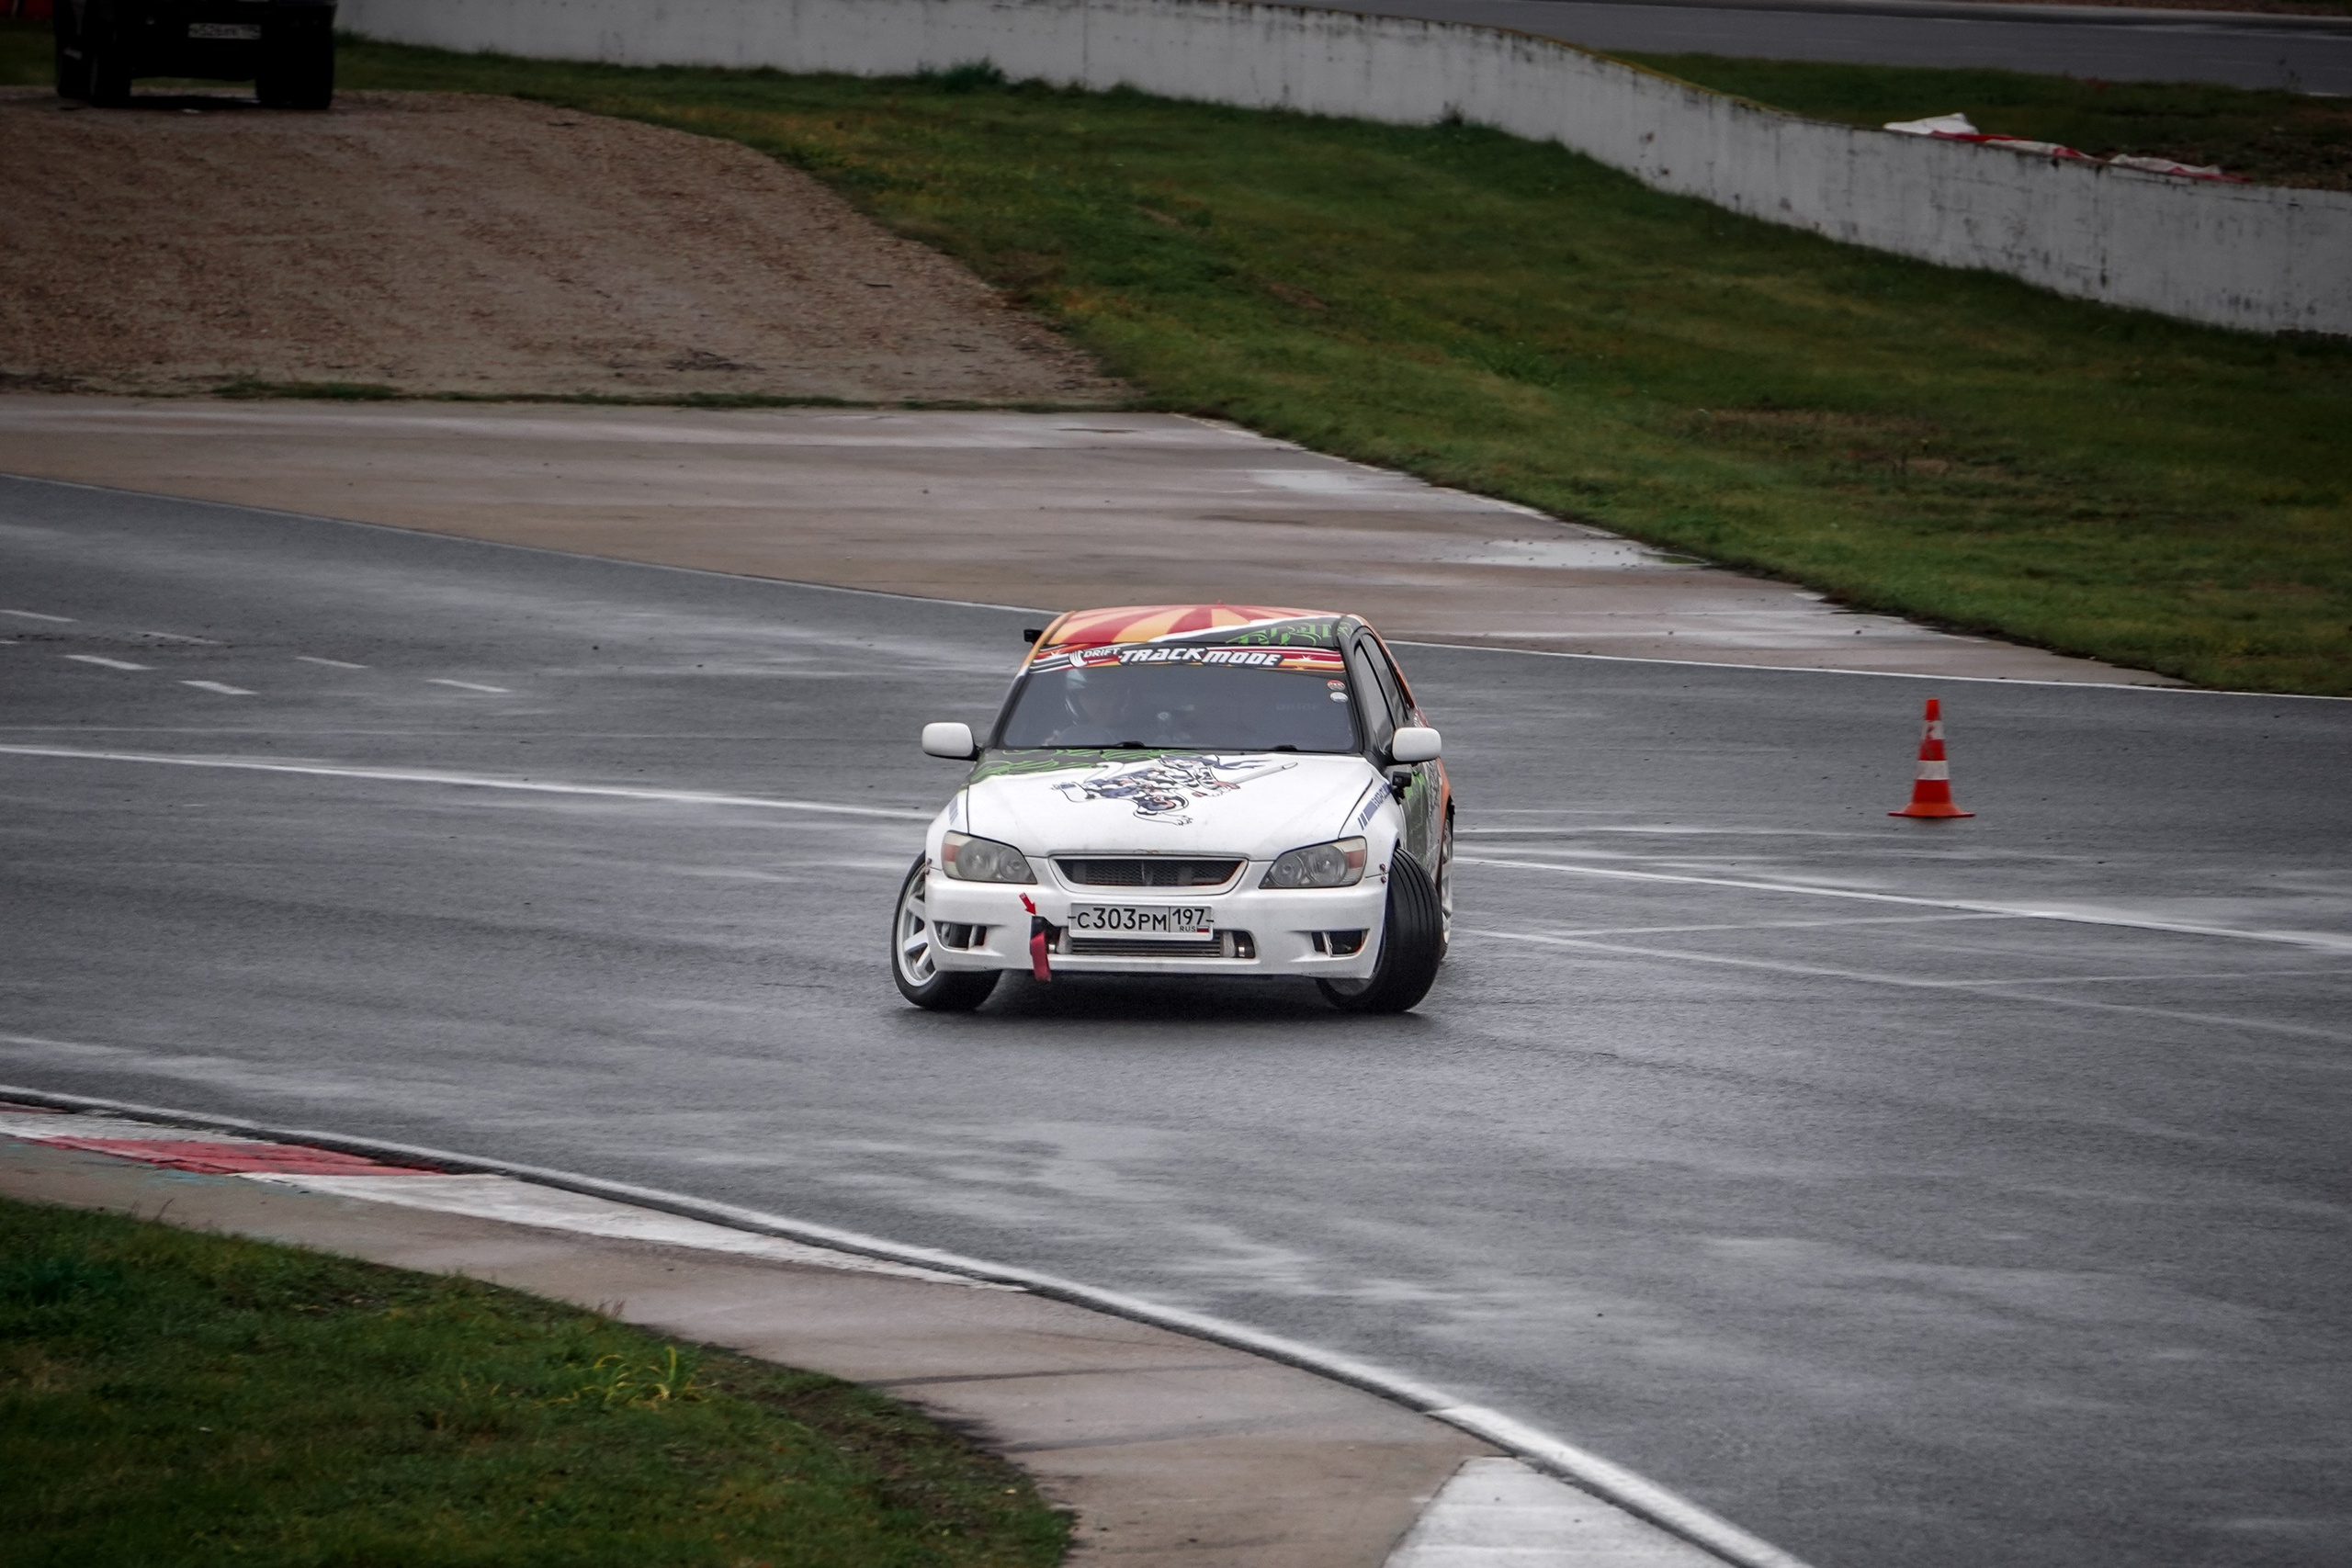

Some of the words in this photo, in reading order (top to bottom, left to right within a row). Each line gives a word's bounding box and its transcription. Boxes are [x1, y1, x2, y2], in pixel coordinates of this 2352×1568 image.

[1083, 649, 1120, 658] DRIFT
[1120, 648, 1205, 663] TRACK
[1202, 650, 1282, 666] MODE
[1171, 908, 1205, 926] 197
[1179, 925, 1196, 933] RUS
